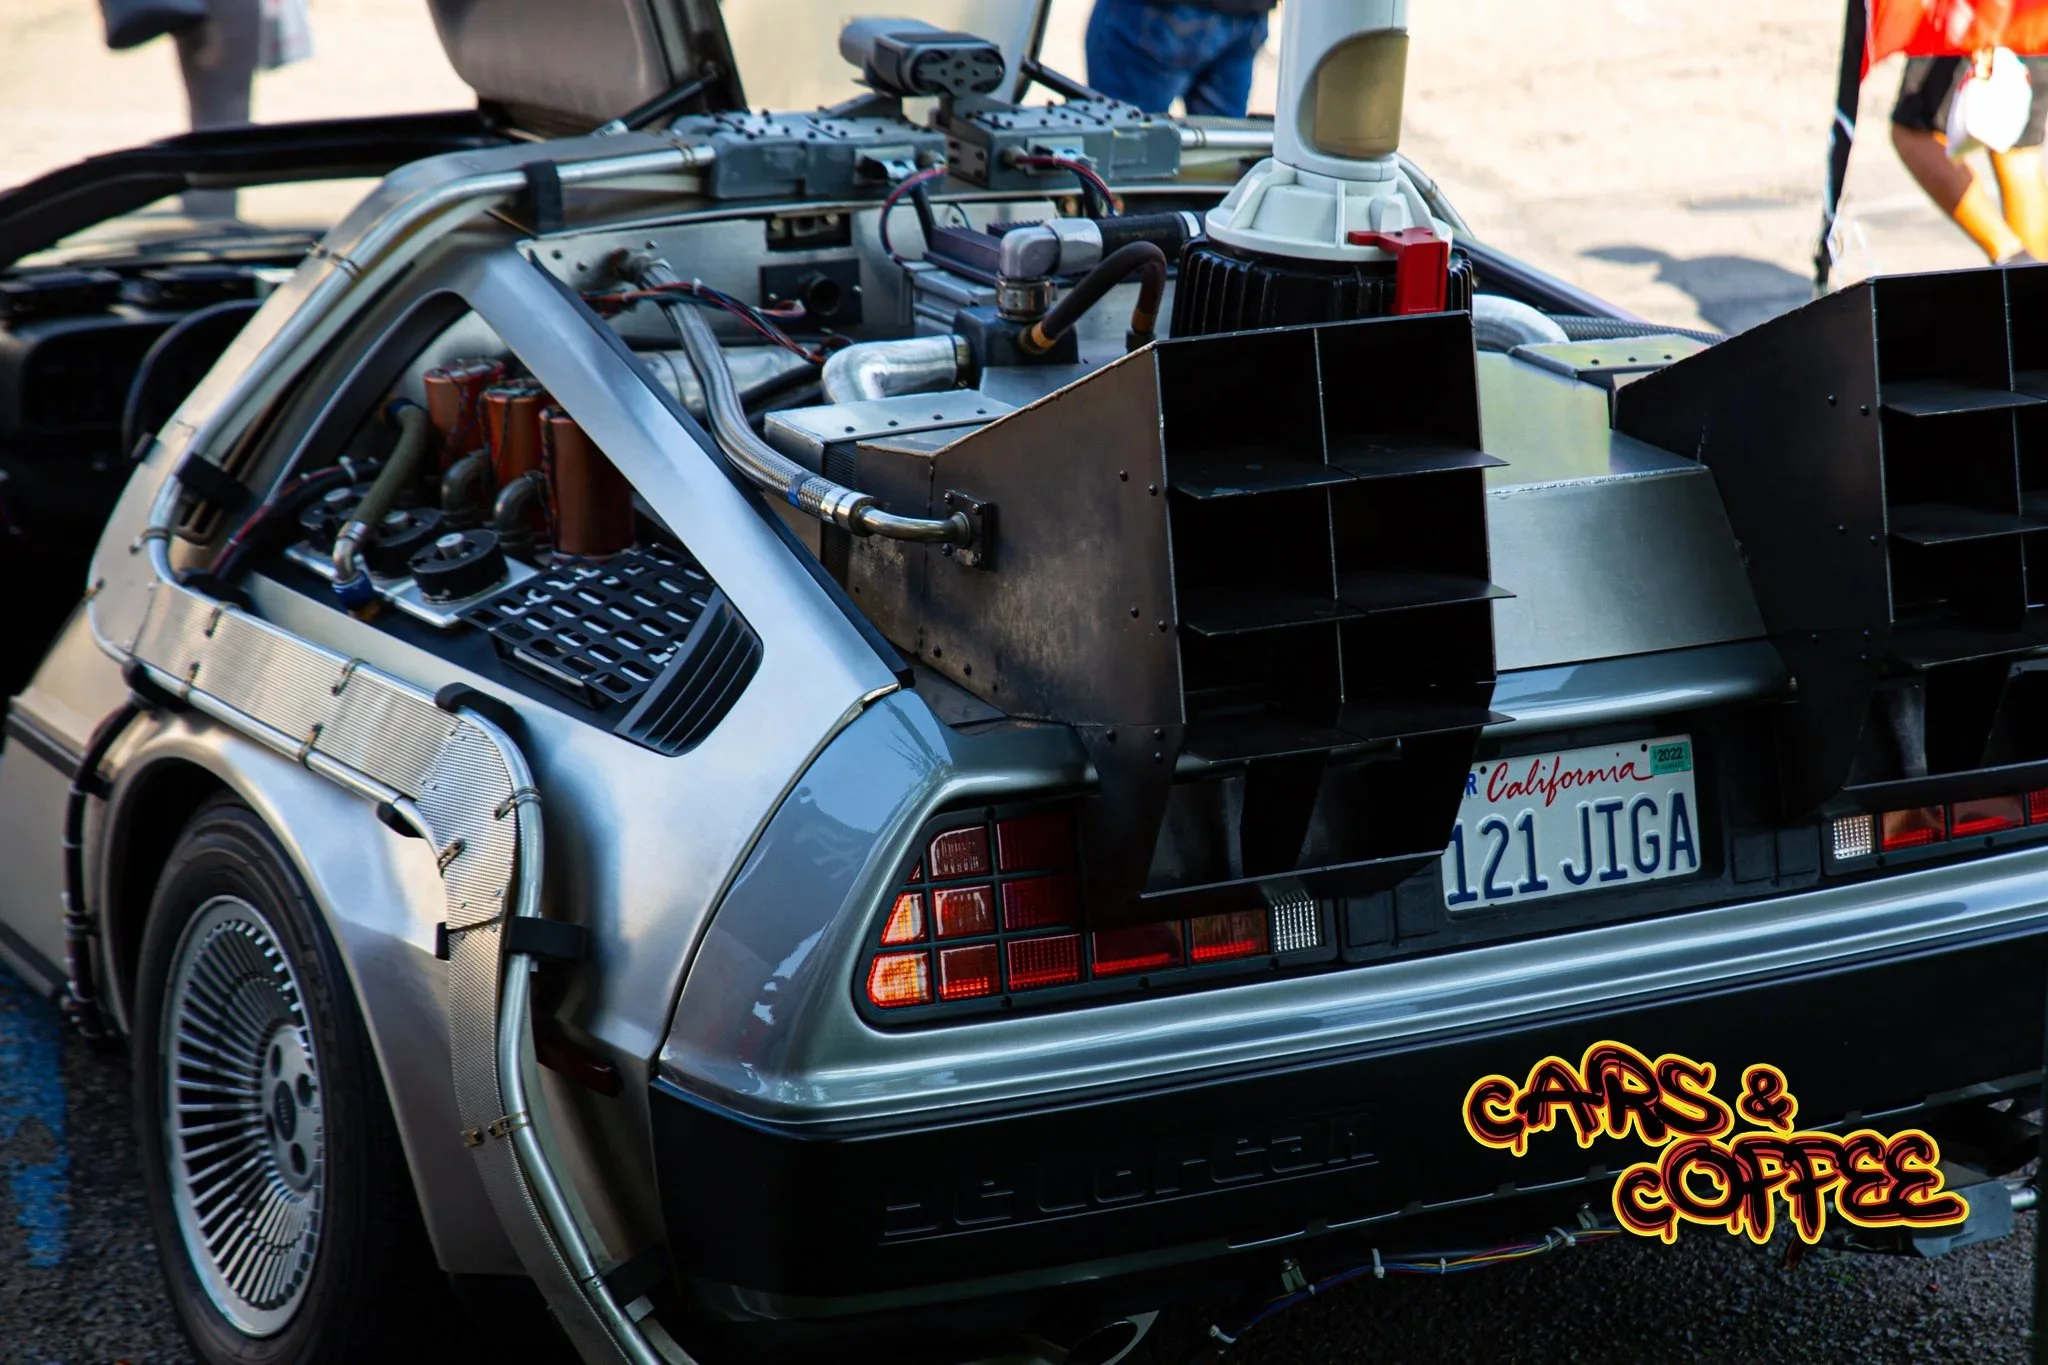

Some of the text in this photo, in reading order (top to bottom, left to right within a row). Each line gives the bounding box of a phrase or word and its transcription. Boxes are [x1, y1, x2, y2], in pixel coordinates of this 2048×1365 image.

[1487, 752, 1654, 807] California
[1657, 746, 1683, 762] 2022
[1447, 790, 1697, 905] 121 JIGA
